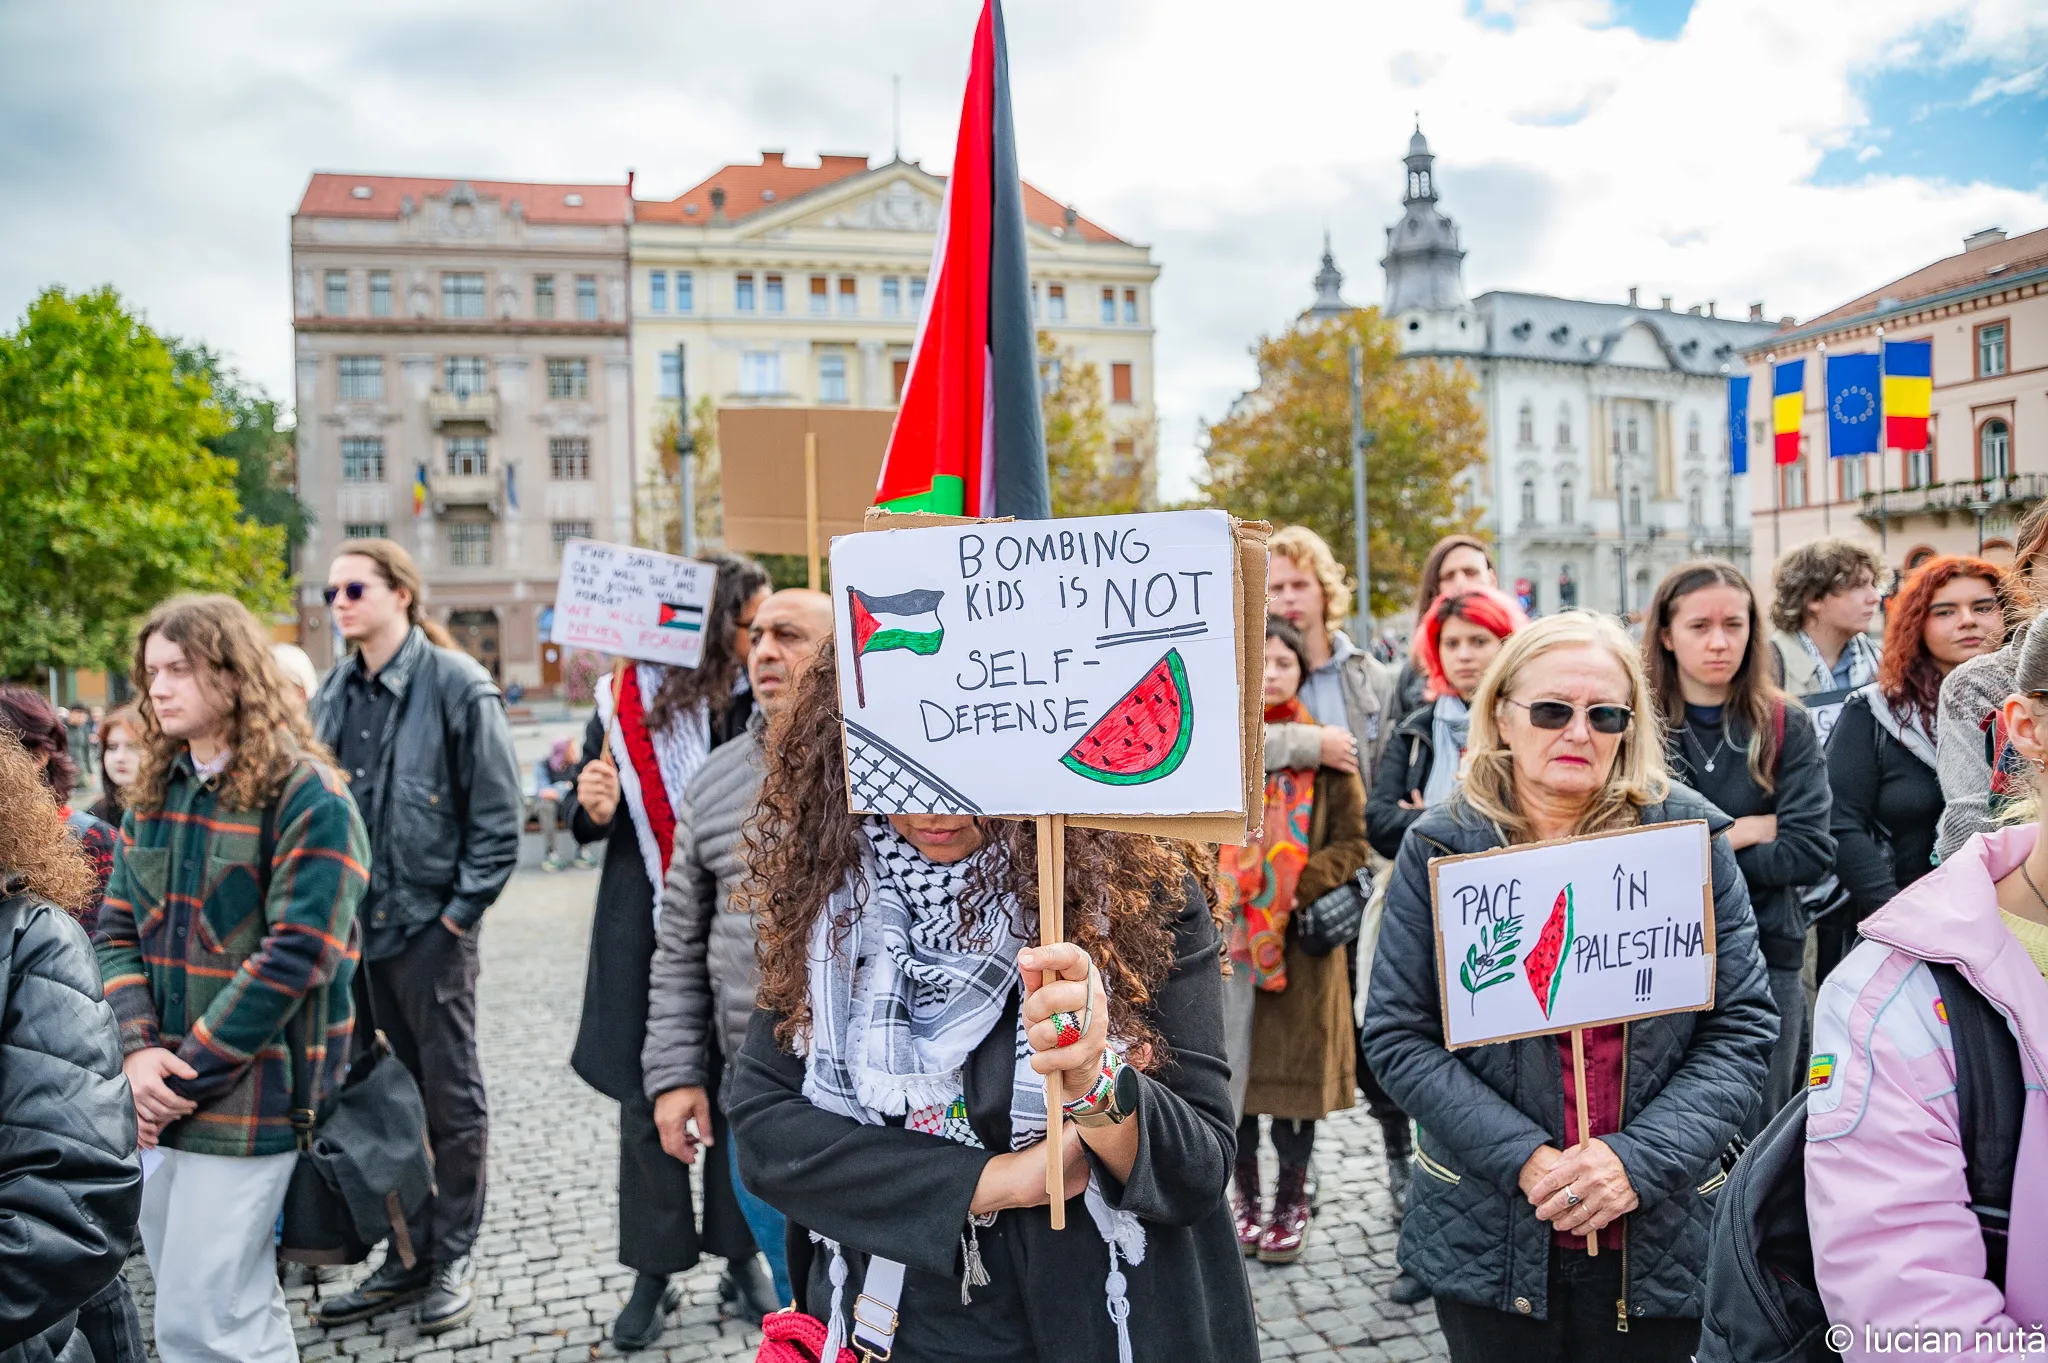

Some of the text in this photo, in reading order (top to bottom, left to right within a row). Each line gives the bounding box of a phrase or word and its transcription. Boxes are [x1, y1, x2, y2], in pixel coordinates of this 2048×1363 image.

[959, 528, 1150, 579] BOMBING
[1104, 571, 1213, 629] NOT
[956, 649, 1100, 691] SELF-
[919, 699, 1089, 742] DEFENSE
[1453, 864, 1648, 925] PACE ÎN
